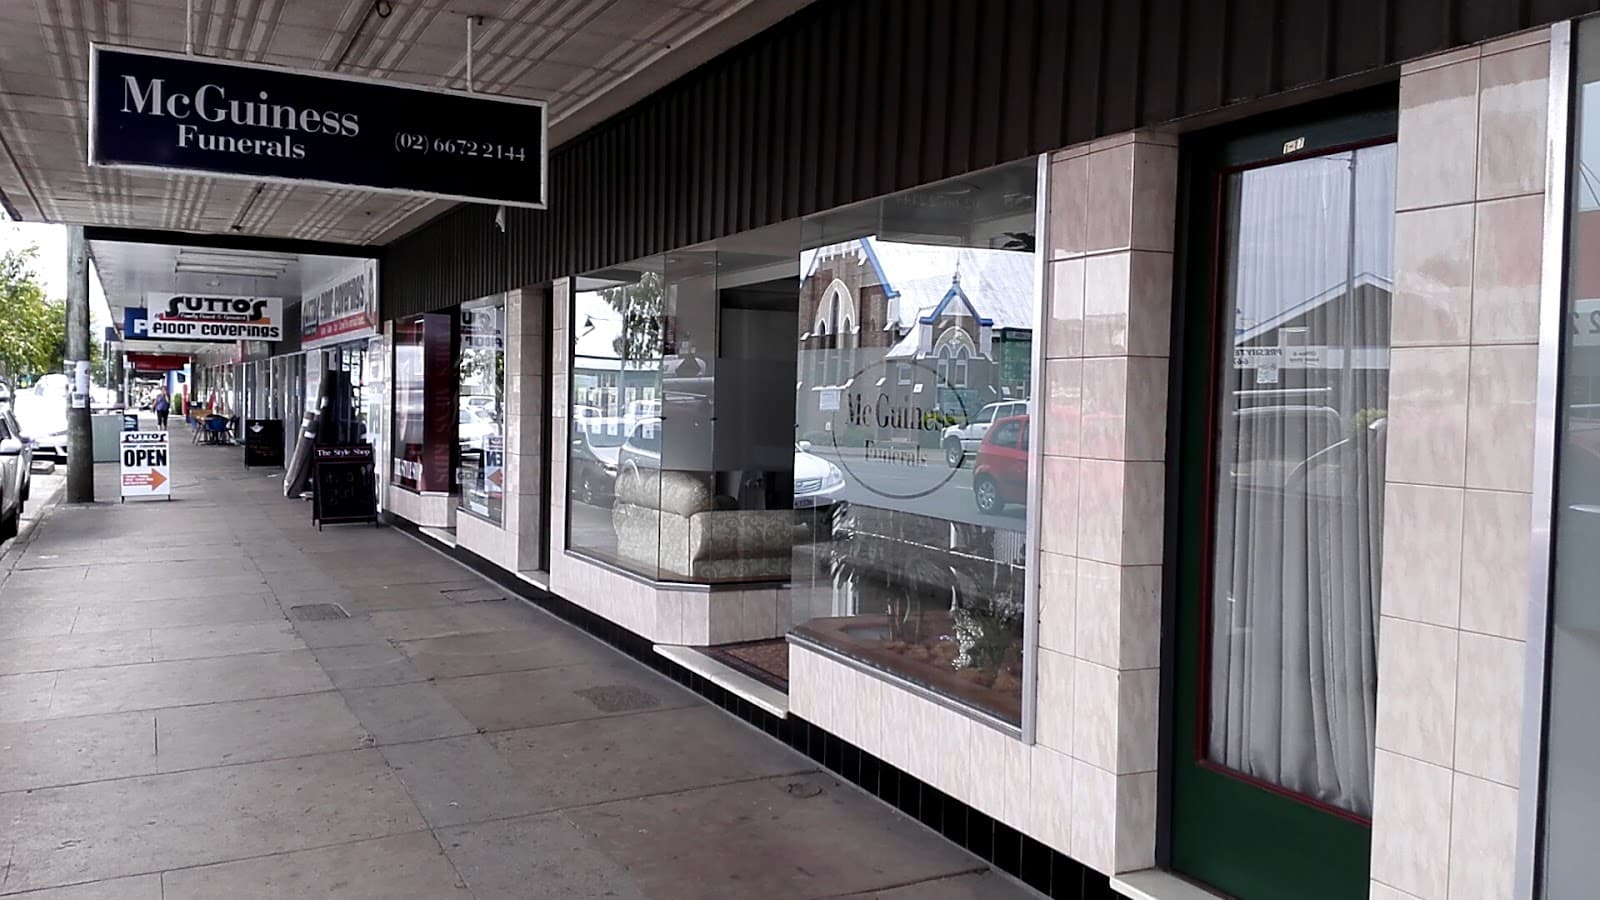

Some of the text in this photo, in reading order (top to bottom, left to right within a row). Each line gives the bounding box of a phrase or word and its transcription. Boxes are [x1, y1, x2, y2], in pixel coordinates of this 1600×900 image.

[120, 74, 359, 137] McGuiness
[176, 123, 306, 160] Funerals
[394, 131, 525, 161] (02) 6672 2144
[152, 322, 280, 337] floor coverings
[124, 449, 167, 467] OPEN
[317, 449, 331, 457] The
